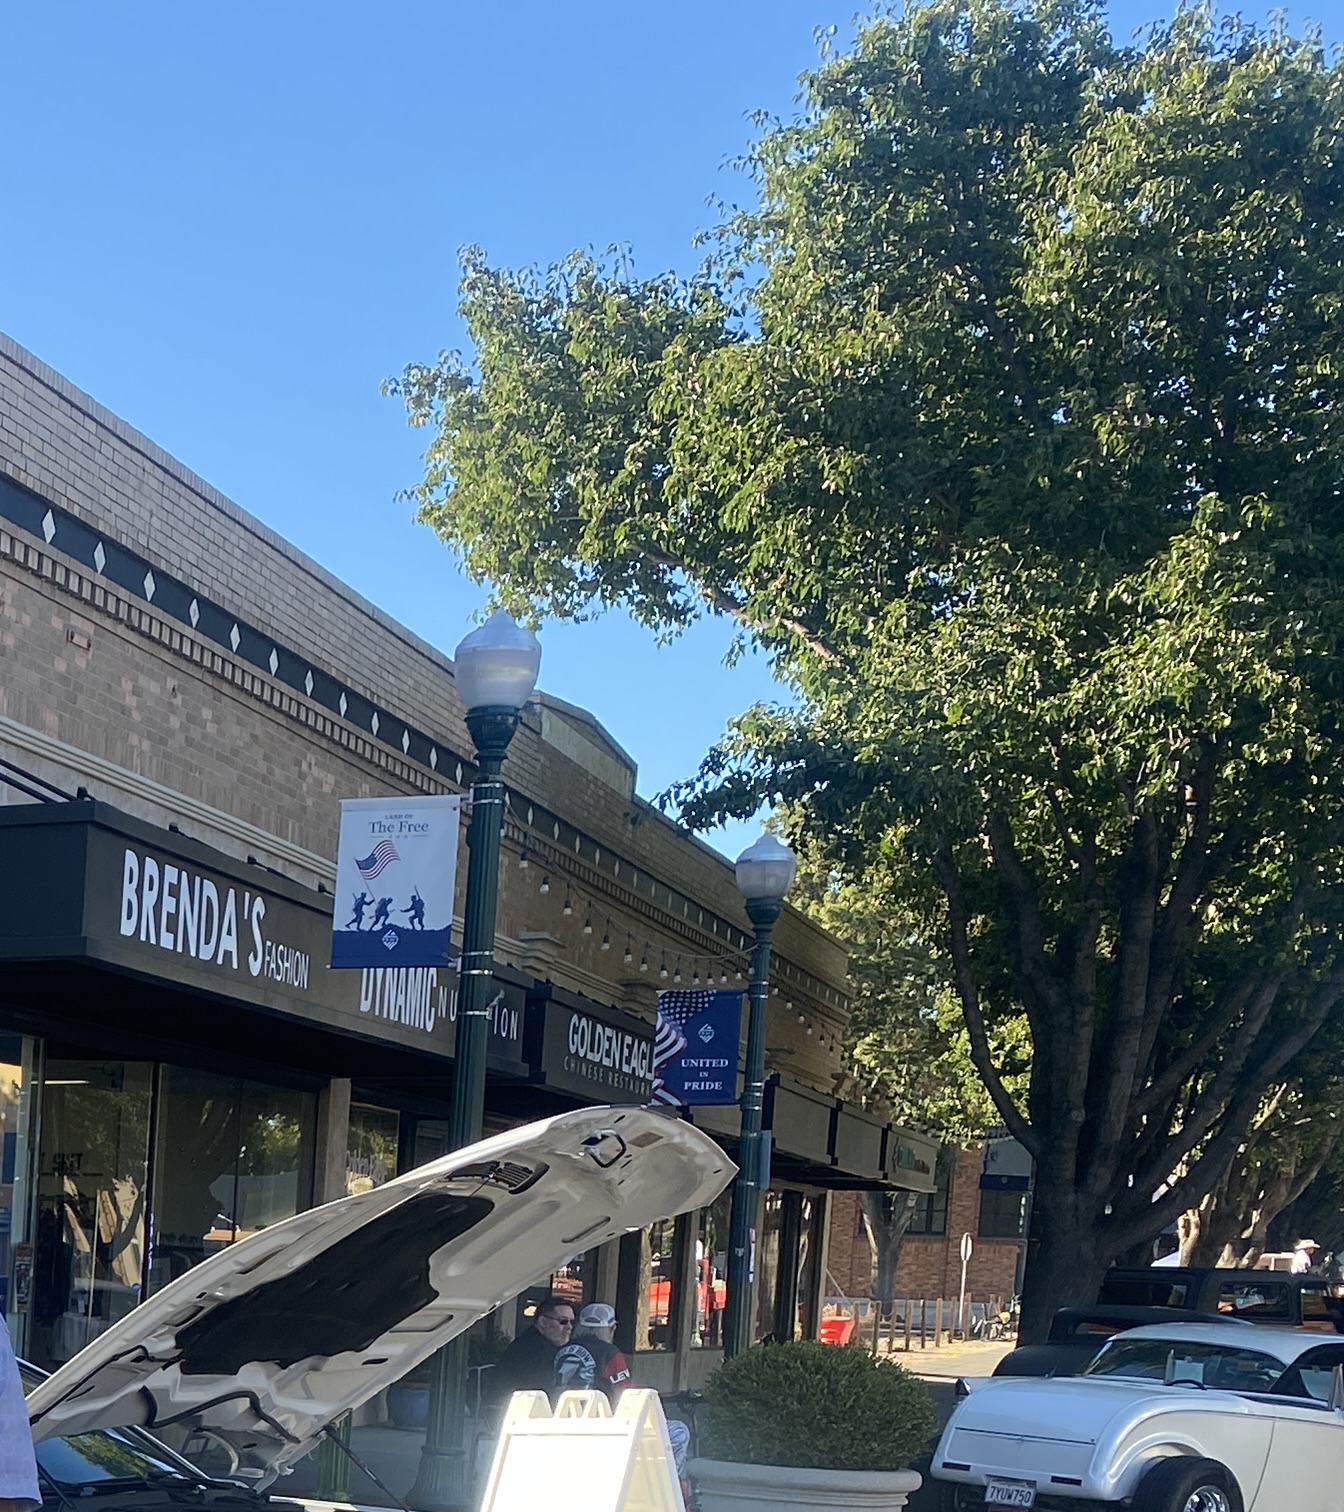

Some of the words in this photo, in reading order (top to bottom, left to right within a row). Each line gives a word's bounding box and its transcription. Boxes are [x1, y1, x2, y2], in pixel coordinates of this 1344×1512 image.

[368, 820, 395, 834] The
[399, 820, 429, 833] Free
[120, 848, 267, 977] BRENDA'S
[263, 940, 310, 990] FASHION
[359, 967, 438, 1033] DYNAMIC
[568, 1013, 623, 1070] GOLDEN
[622, 1033, 655, 1081] EAGL
[563, 1056, 604, 1083] CHINESE
[608, 1071, 651, 1096] RESTAURA
[681, 1058, 729, 1068] UNITED
[699, 1071, 709, 1079] IN
[683, 1080, 723, 1091] PRIDE
